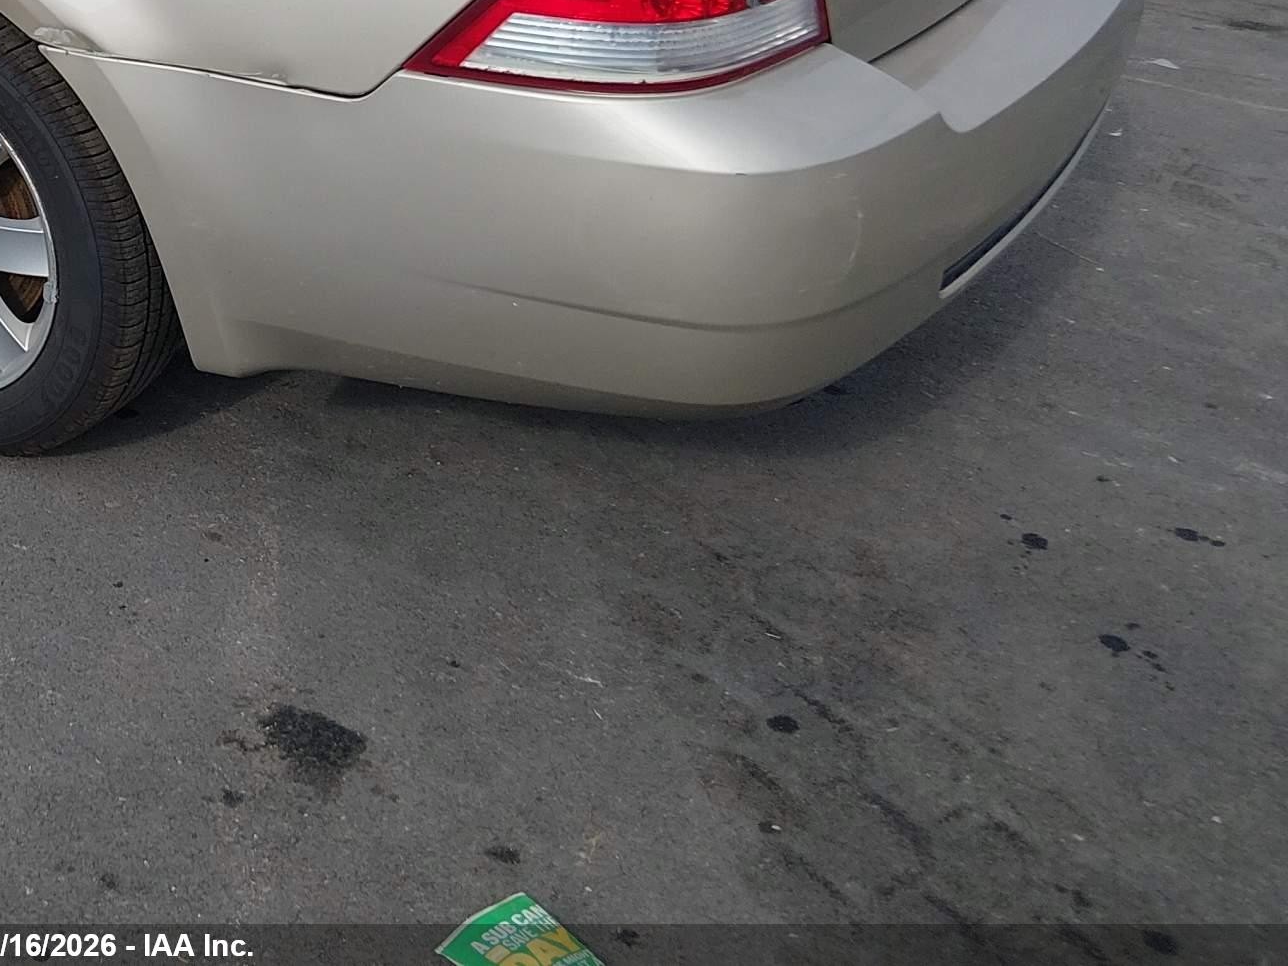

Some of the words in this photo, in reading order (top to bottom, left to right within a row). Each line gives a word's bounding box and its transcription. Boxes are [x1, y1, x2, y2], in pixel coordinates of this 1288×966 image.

[469, 940, 491, 955] A
[481, 921, 517, 946] SUB
[502, 925, 540, 951] SAVE
